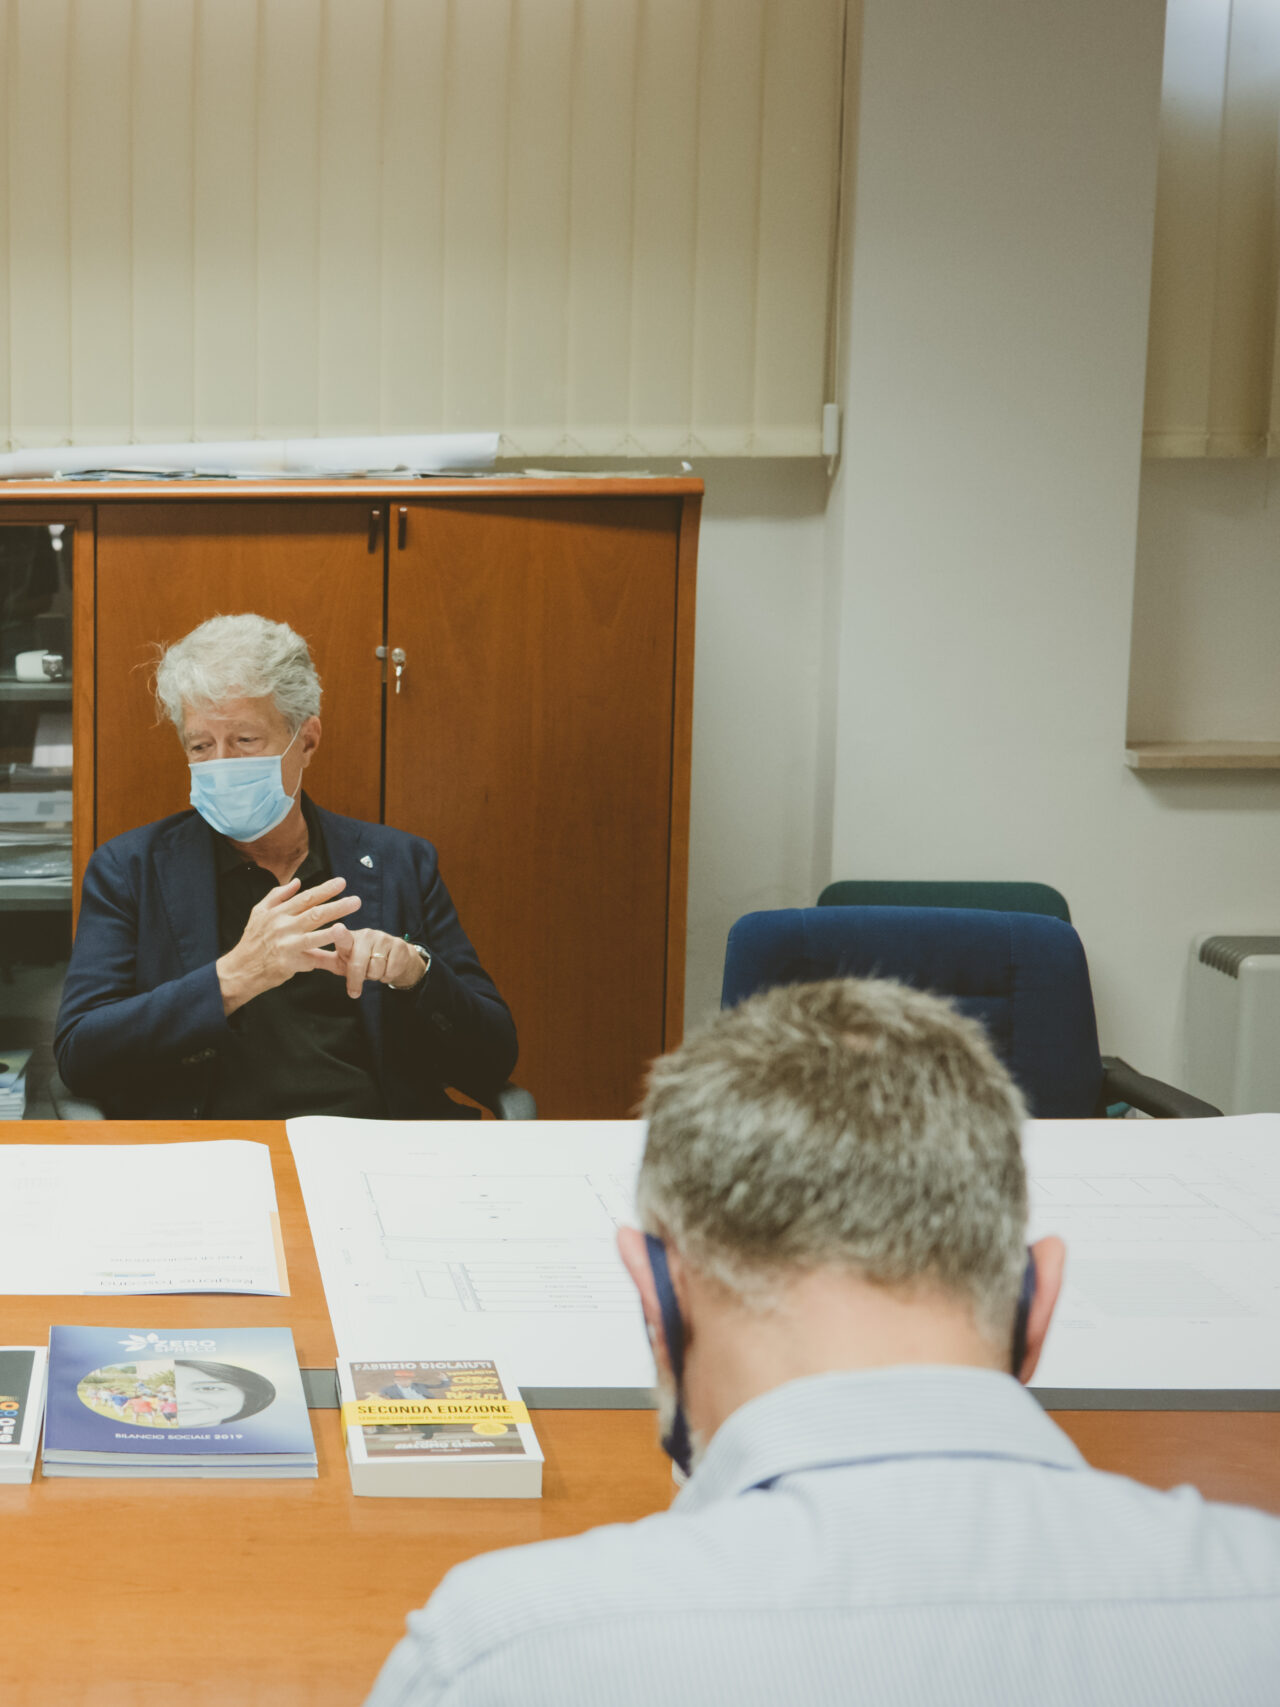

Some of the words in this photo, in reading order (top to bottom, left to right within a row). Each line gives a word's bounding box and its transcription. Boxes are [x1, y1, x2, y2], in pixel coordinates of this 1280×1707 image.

[354, 1362, 417, 1371] FABRIZIO
[358, 1405, 433, 1414] SECONDA
[437, 1405, 513, 1413] EDIZIONE
